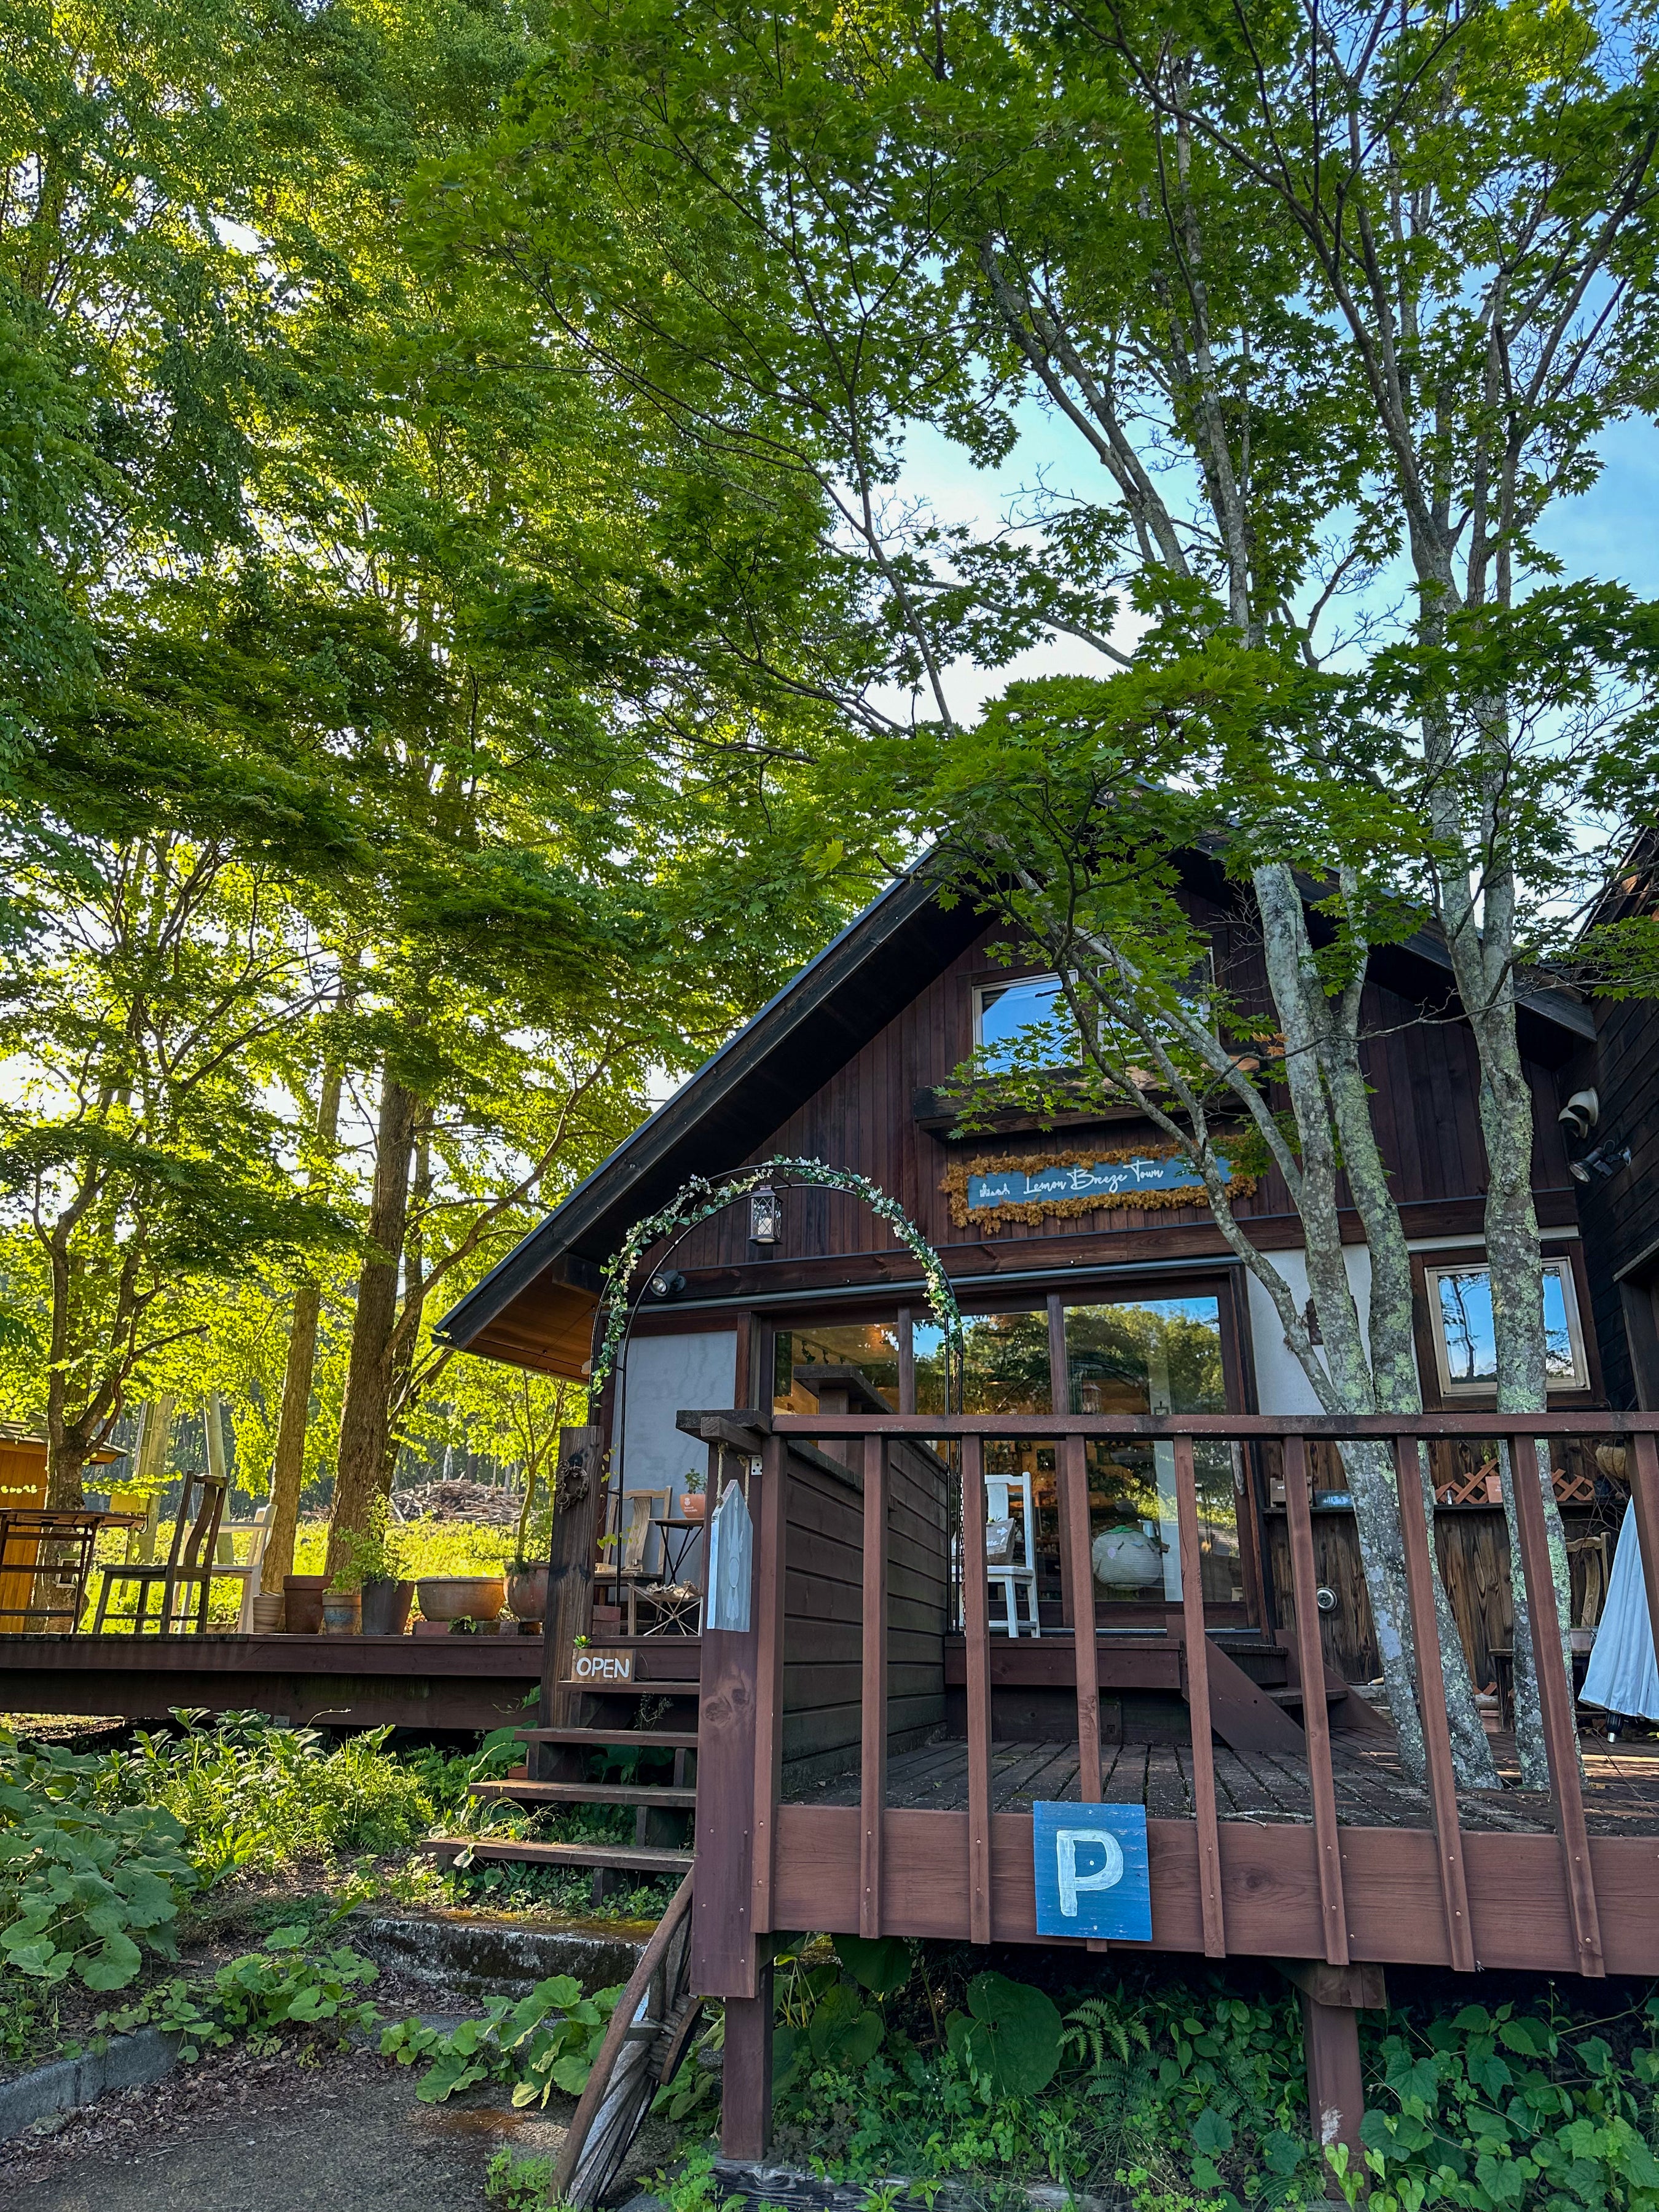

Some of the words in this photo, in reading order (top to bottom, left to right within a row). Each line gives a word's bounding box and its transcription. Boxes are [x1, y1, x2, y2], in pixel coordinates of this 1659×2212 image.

[1023, 1175, 1067, 1195] Lemon
[1066, 1168, 1128, 1193] Breeze
[1123, 1159, 1164, 1182] Town
[576, 1657, 630, 1678] OPEN
[1056, 1829, 1124, 1917] P
